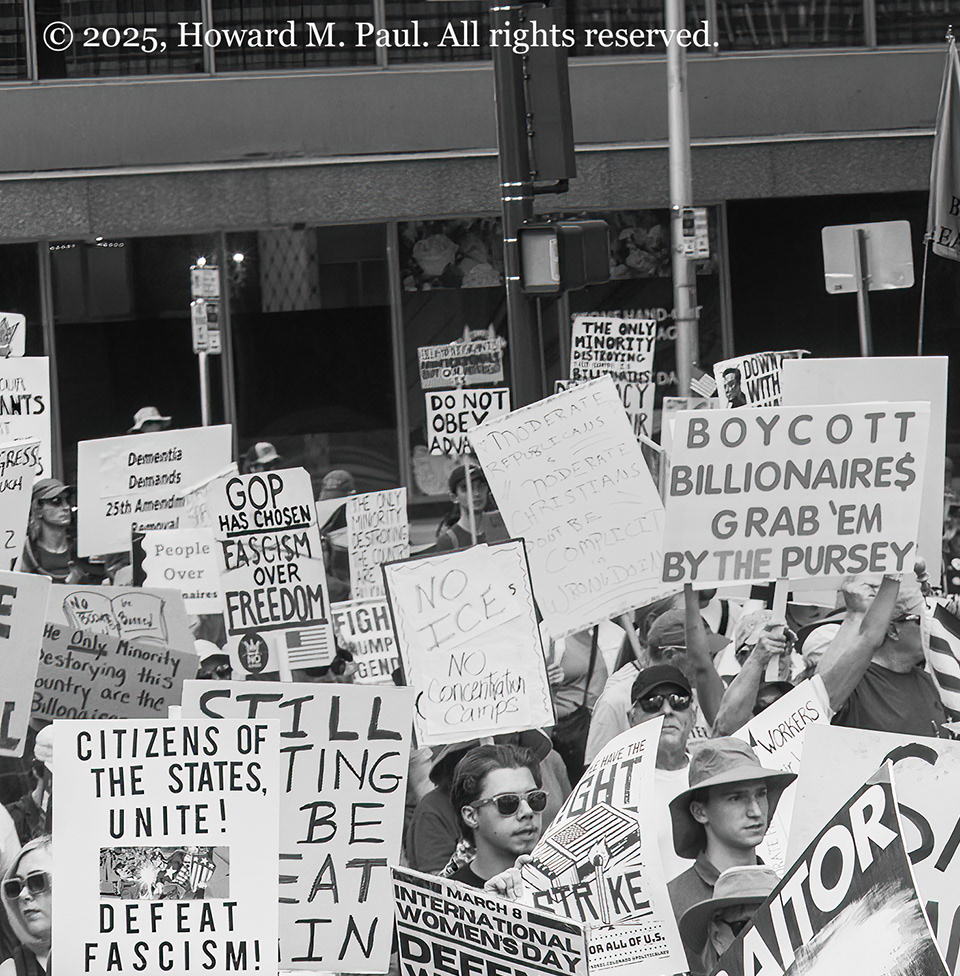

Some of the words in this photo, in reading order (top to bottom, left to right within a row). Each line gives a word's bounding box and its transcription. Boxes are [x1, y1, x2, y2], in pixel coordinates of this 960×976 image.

[574, 335, 655, 353] MINORITY
[582, 321, 612, 335] THE
[618, 321, 655, 336] ONLY
[573, 350, 646, 363] DESTROYING
[743, 352, 778, 380] DOWN
[430, 394, 456, 411] DO
[463, 390, 508, 410] NOT
[746, 371, 781, 404] WITH
[432, 410, 489, 434] OBEY
[487, 391, 608, 451] MODERATE
[687, 411, 916, 449] BOYCOTT
[128, 446, 183, 467] Dementia
[485, 415, 605, 479] REPUBLICANS
[128, 469, 182, 490] Demands
[520, 442, 632, 497] MODERATE
[670, 452, 917, 496] BILLIONAIRE$
[106, 500, 132, 517] 25th
[225, 473, 284, 511] GOP
[511, 462, 641, 535] CHRISTIANS
[218, 510, 250, 532] HAS
[254, 504, 312, 528] CHOSEN
[567, 511, 602, 532] BE
[711, 505, 820, 540] GRAB
[155, 543, 210, 558] People
[221, 532, 313, 571] FASCISM
[662, 550, 709, 583] BY
[712, 548, 773, 581] THE
[781, 541, 915, 578] PURSEY
[164, 567, 205, 581] Over
[253, 563, 303, 587] OVER
[225, 584, 326, 630] FREEDOM
[415, 569, 468, 614] NO
[70, 630, 107, 661] Only
[115, 639, 181, 678] Minority
[448, 650, 487, 677] NO
[138, 665, 174, 690] this
[100, 689, 131, 704] are
[136, 689, 165, 712] the
[199, 689, 403, 741] STILL
[443, 696, 520, 726] Camps
[76, 725, 220, 762] CITIZENS
[236, 724, 269, 755] OF
[756, 700, 820, 755] WORKERS
[600, 747, 624, 766] HAVE
[625, 739, 647, 756] THE
[90, 765, 145, 798] THE
[167, 761, 268, 797] STATES,
[109, 798, 228, 839] UNITE!
[297, 800, 386, 845] BE
[99, 901, 239, 934] DEFEAT
[394, 884, 583, 954] INTERNATIONAL
[445, 886, 507, 915] MARCH
[511, 907, 523, 920] 8
[395, 901, 520, 955] WOMEN'S
[522, 941, 583, 973] DAY
[606, 938, 628, 952] ALL
[628, 935, 643, 948] OF
[644, 931, 666, 945] U.S.
[84, 939, 262, 973] FASCISM!
